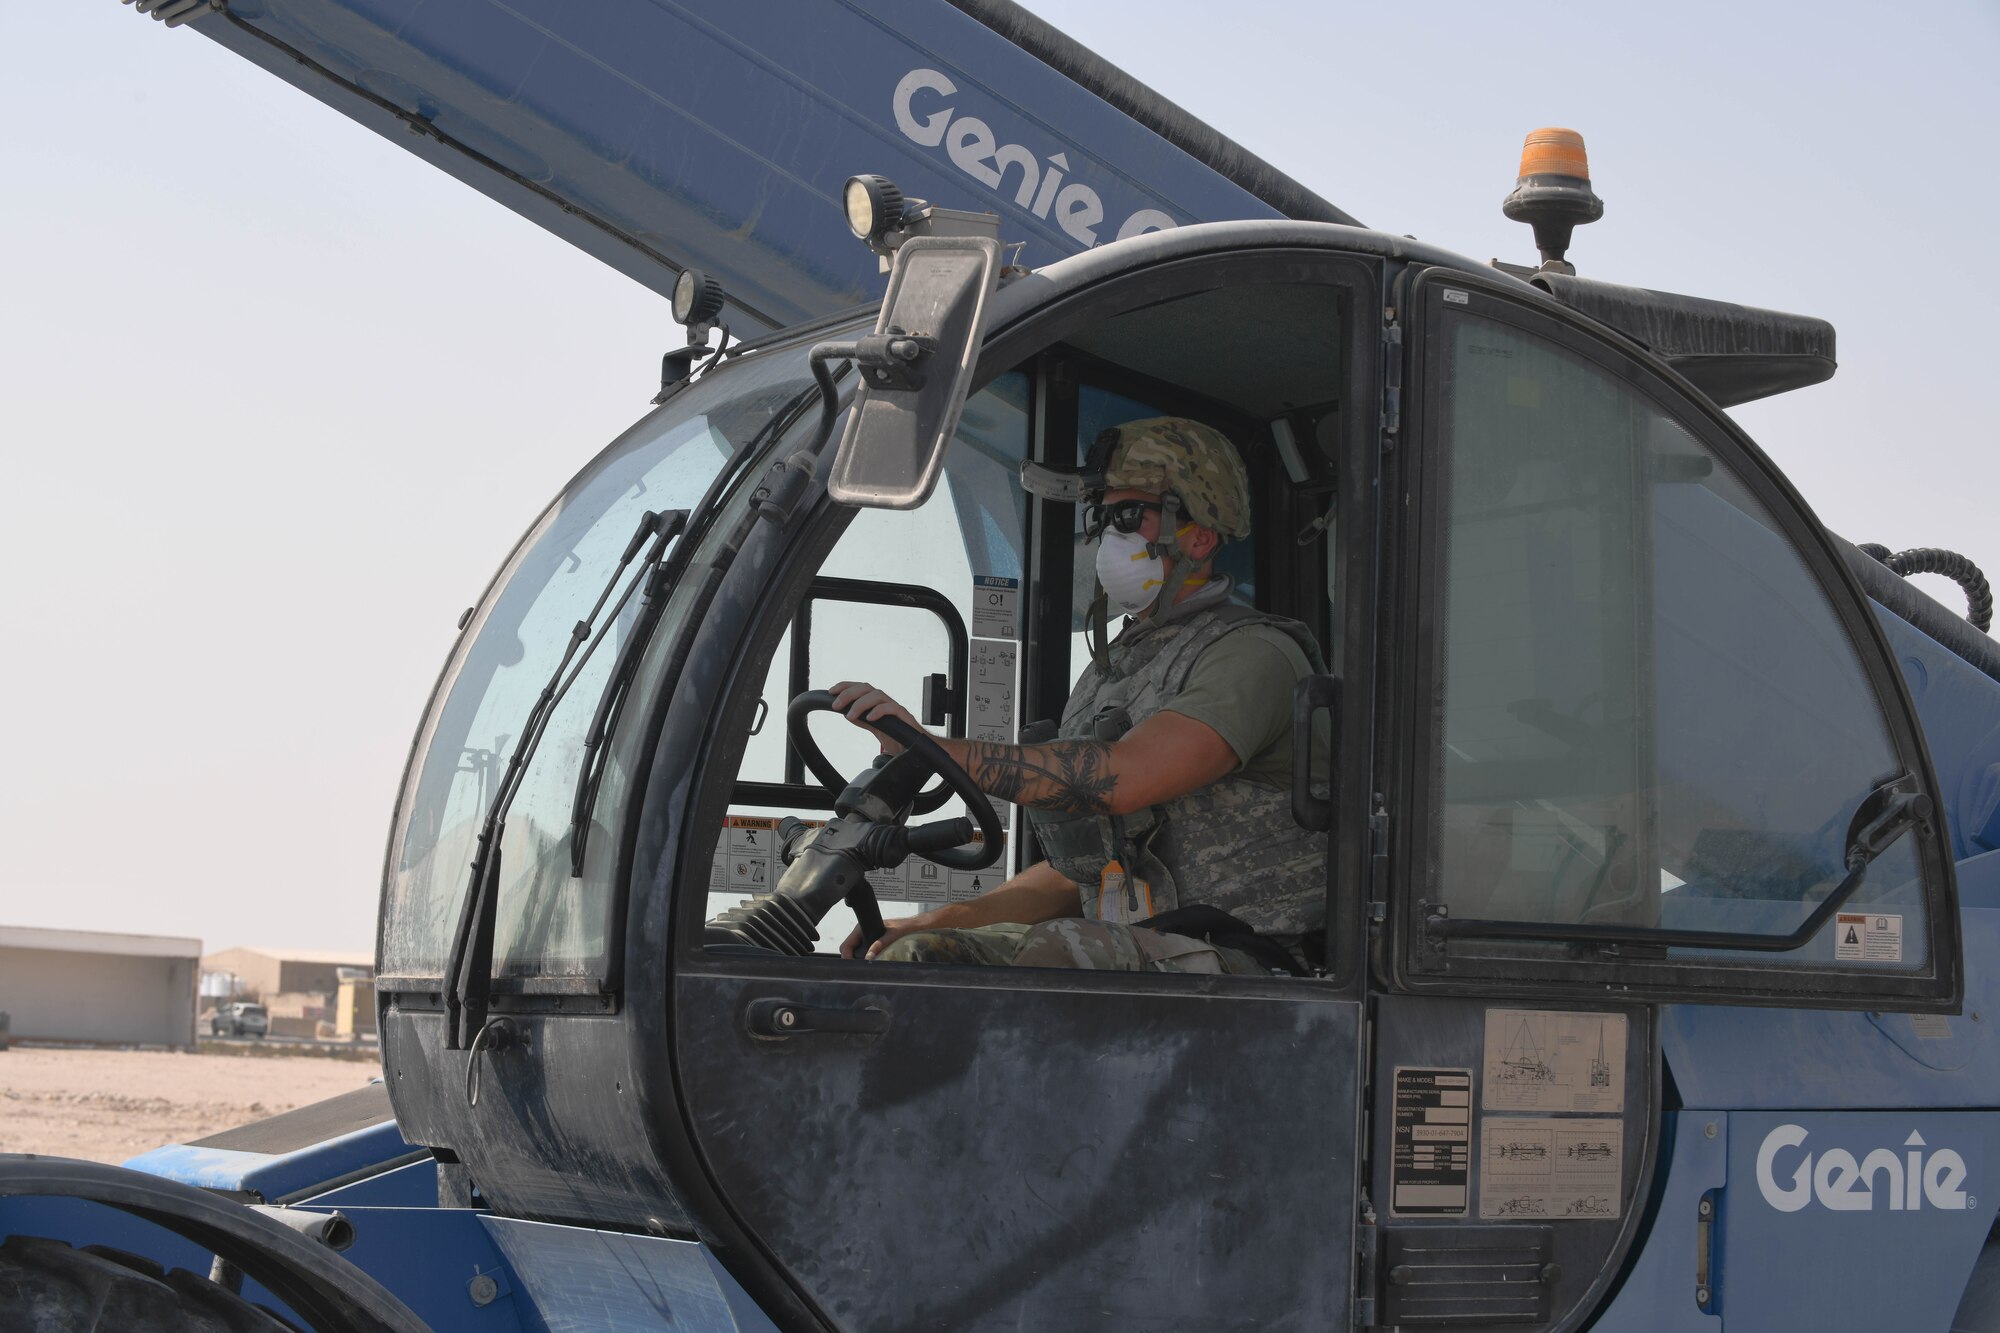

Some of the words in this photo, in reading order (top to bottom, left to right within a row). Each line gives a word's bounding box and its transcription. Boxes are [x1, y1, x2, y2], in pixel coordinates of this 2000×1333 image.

[892, 68, 1104, 249] Genie
[984, 577, 1010, 587] NOTICE
[740, 818, 772, 829] WARNING
[1416, 1129, 1464, 1137] 3930-01-647-7904
[1756, 1124, 1968, 1212] Genie
